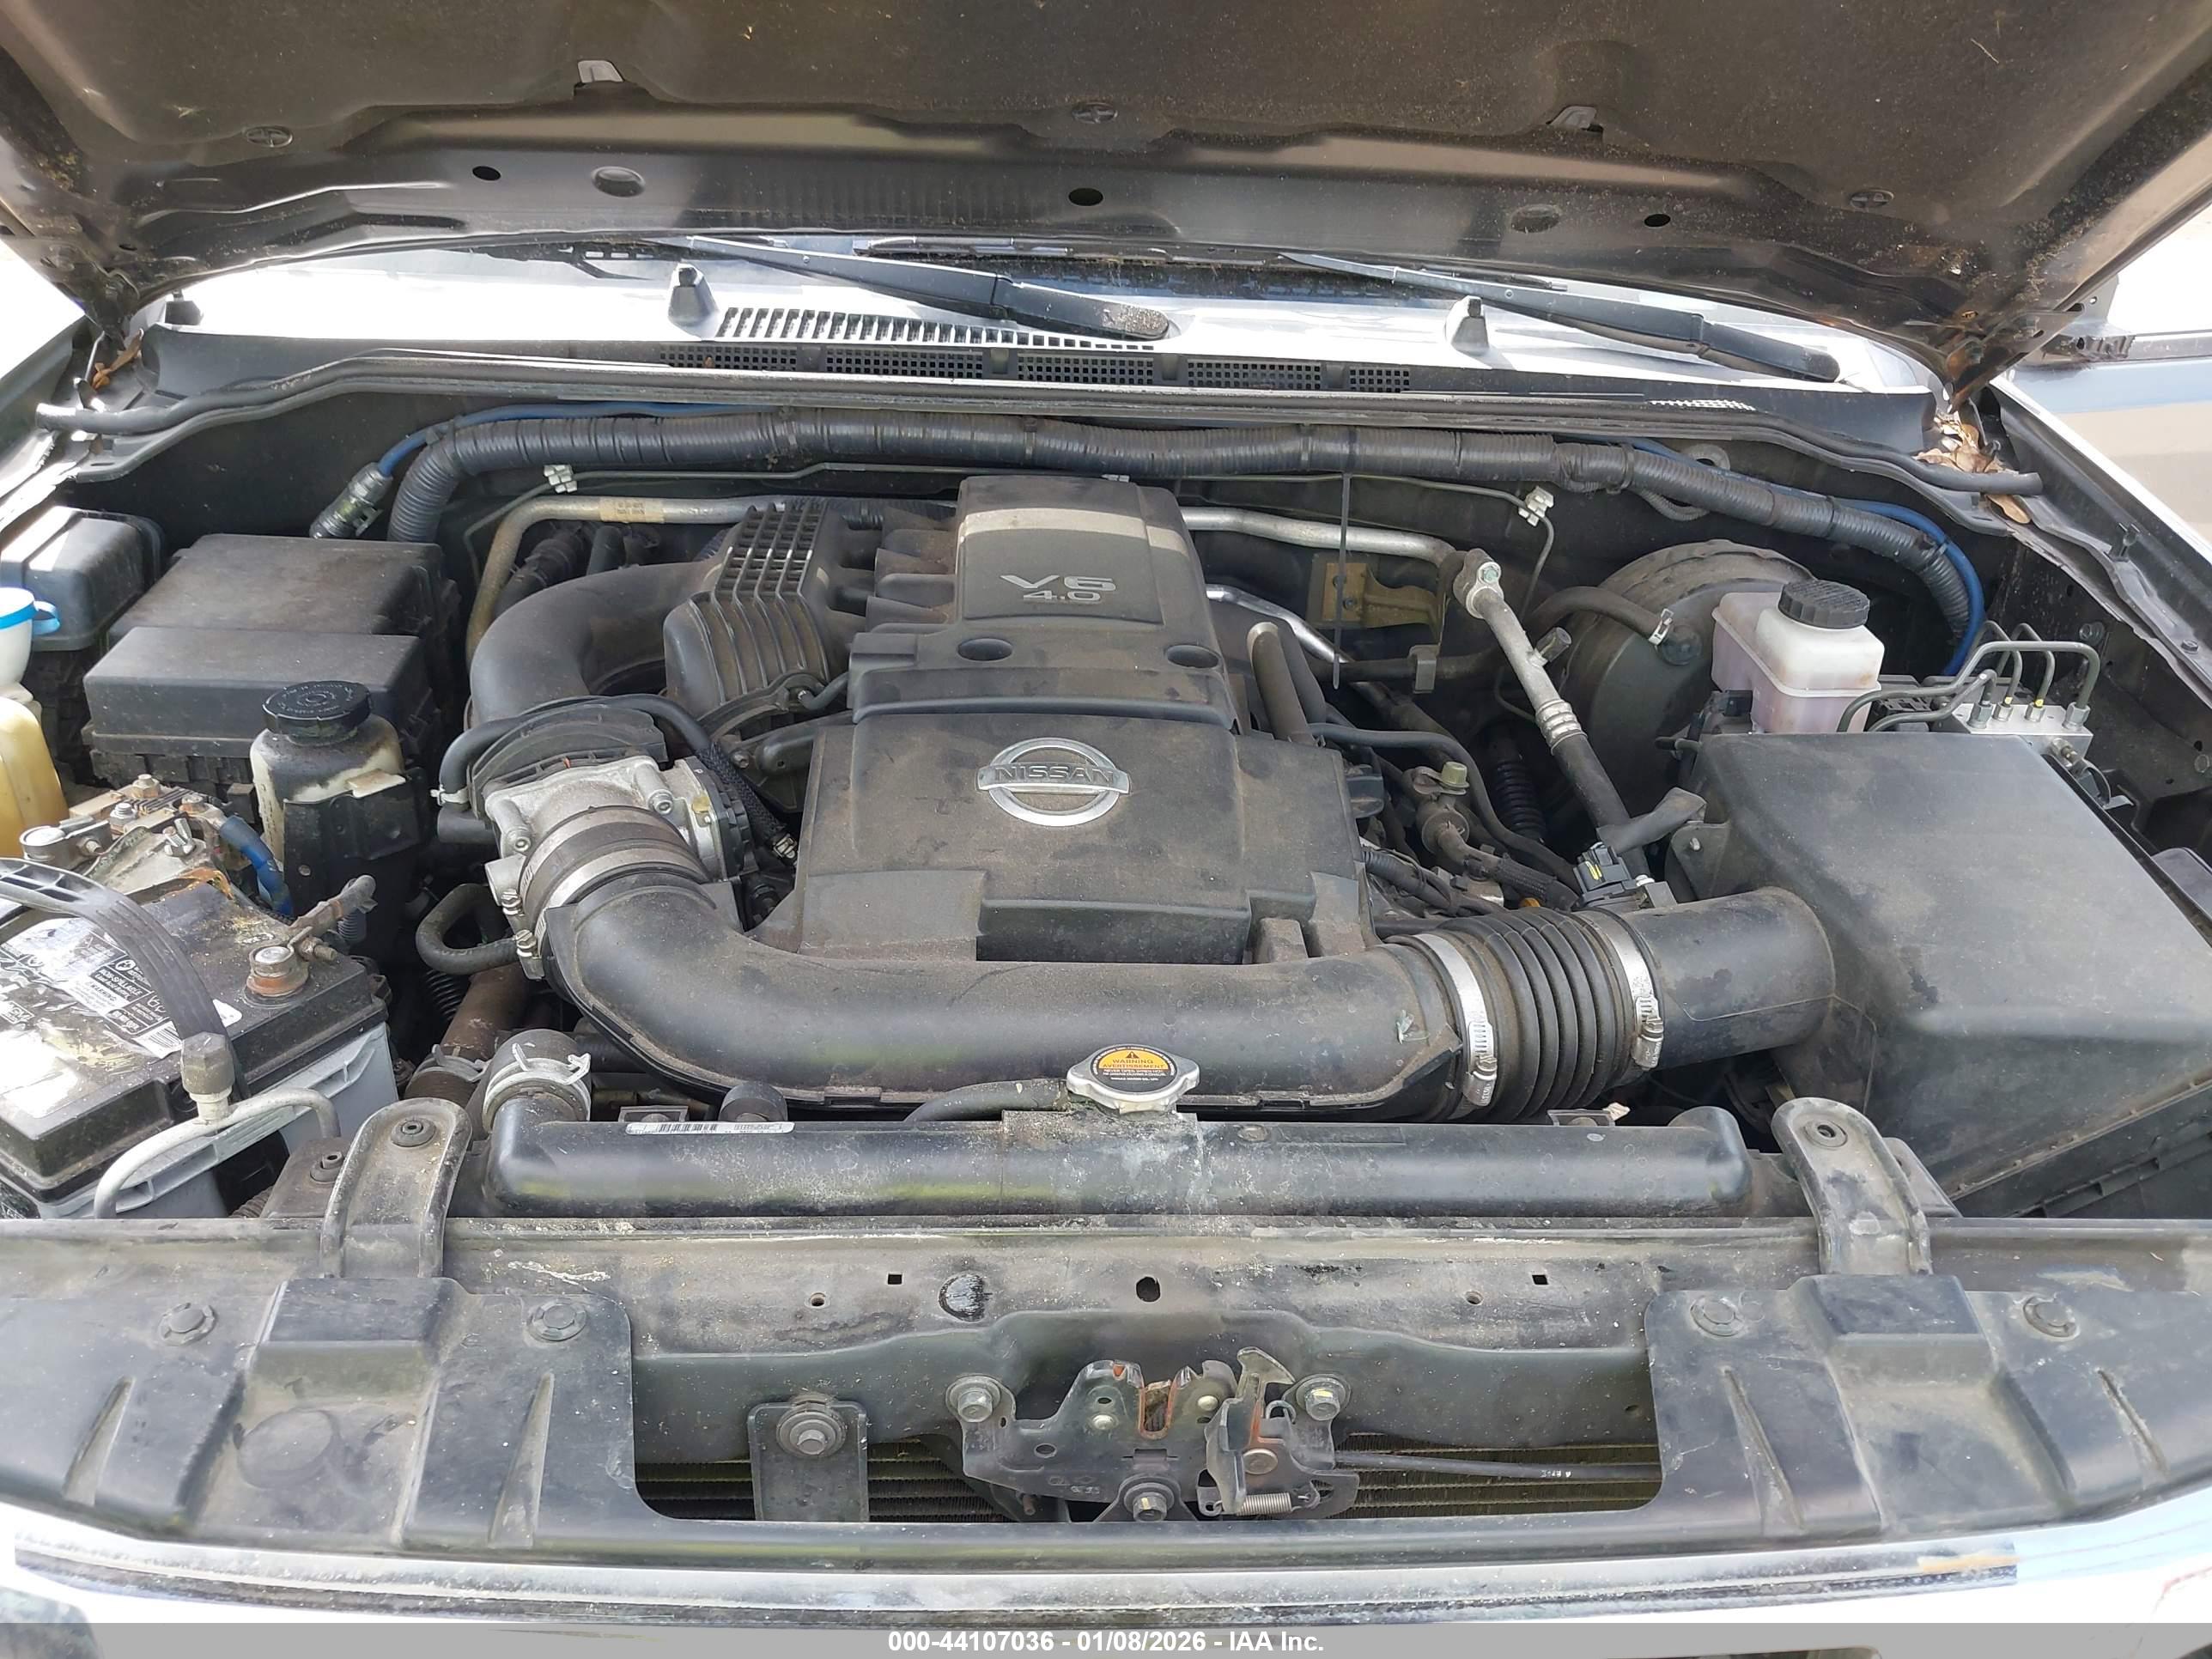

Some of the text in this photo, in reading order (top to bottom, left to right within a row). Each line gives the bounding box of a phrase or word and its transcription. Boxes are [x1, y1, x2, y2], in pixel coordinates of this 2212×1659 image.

[1000, 574, 1116, 592] V6
[1023, 590, 1101, 601] 4.0
[995, 765, 1114, 782] NISSAN
